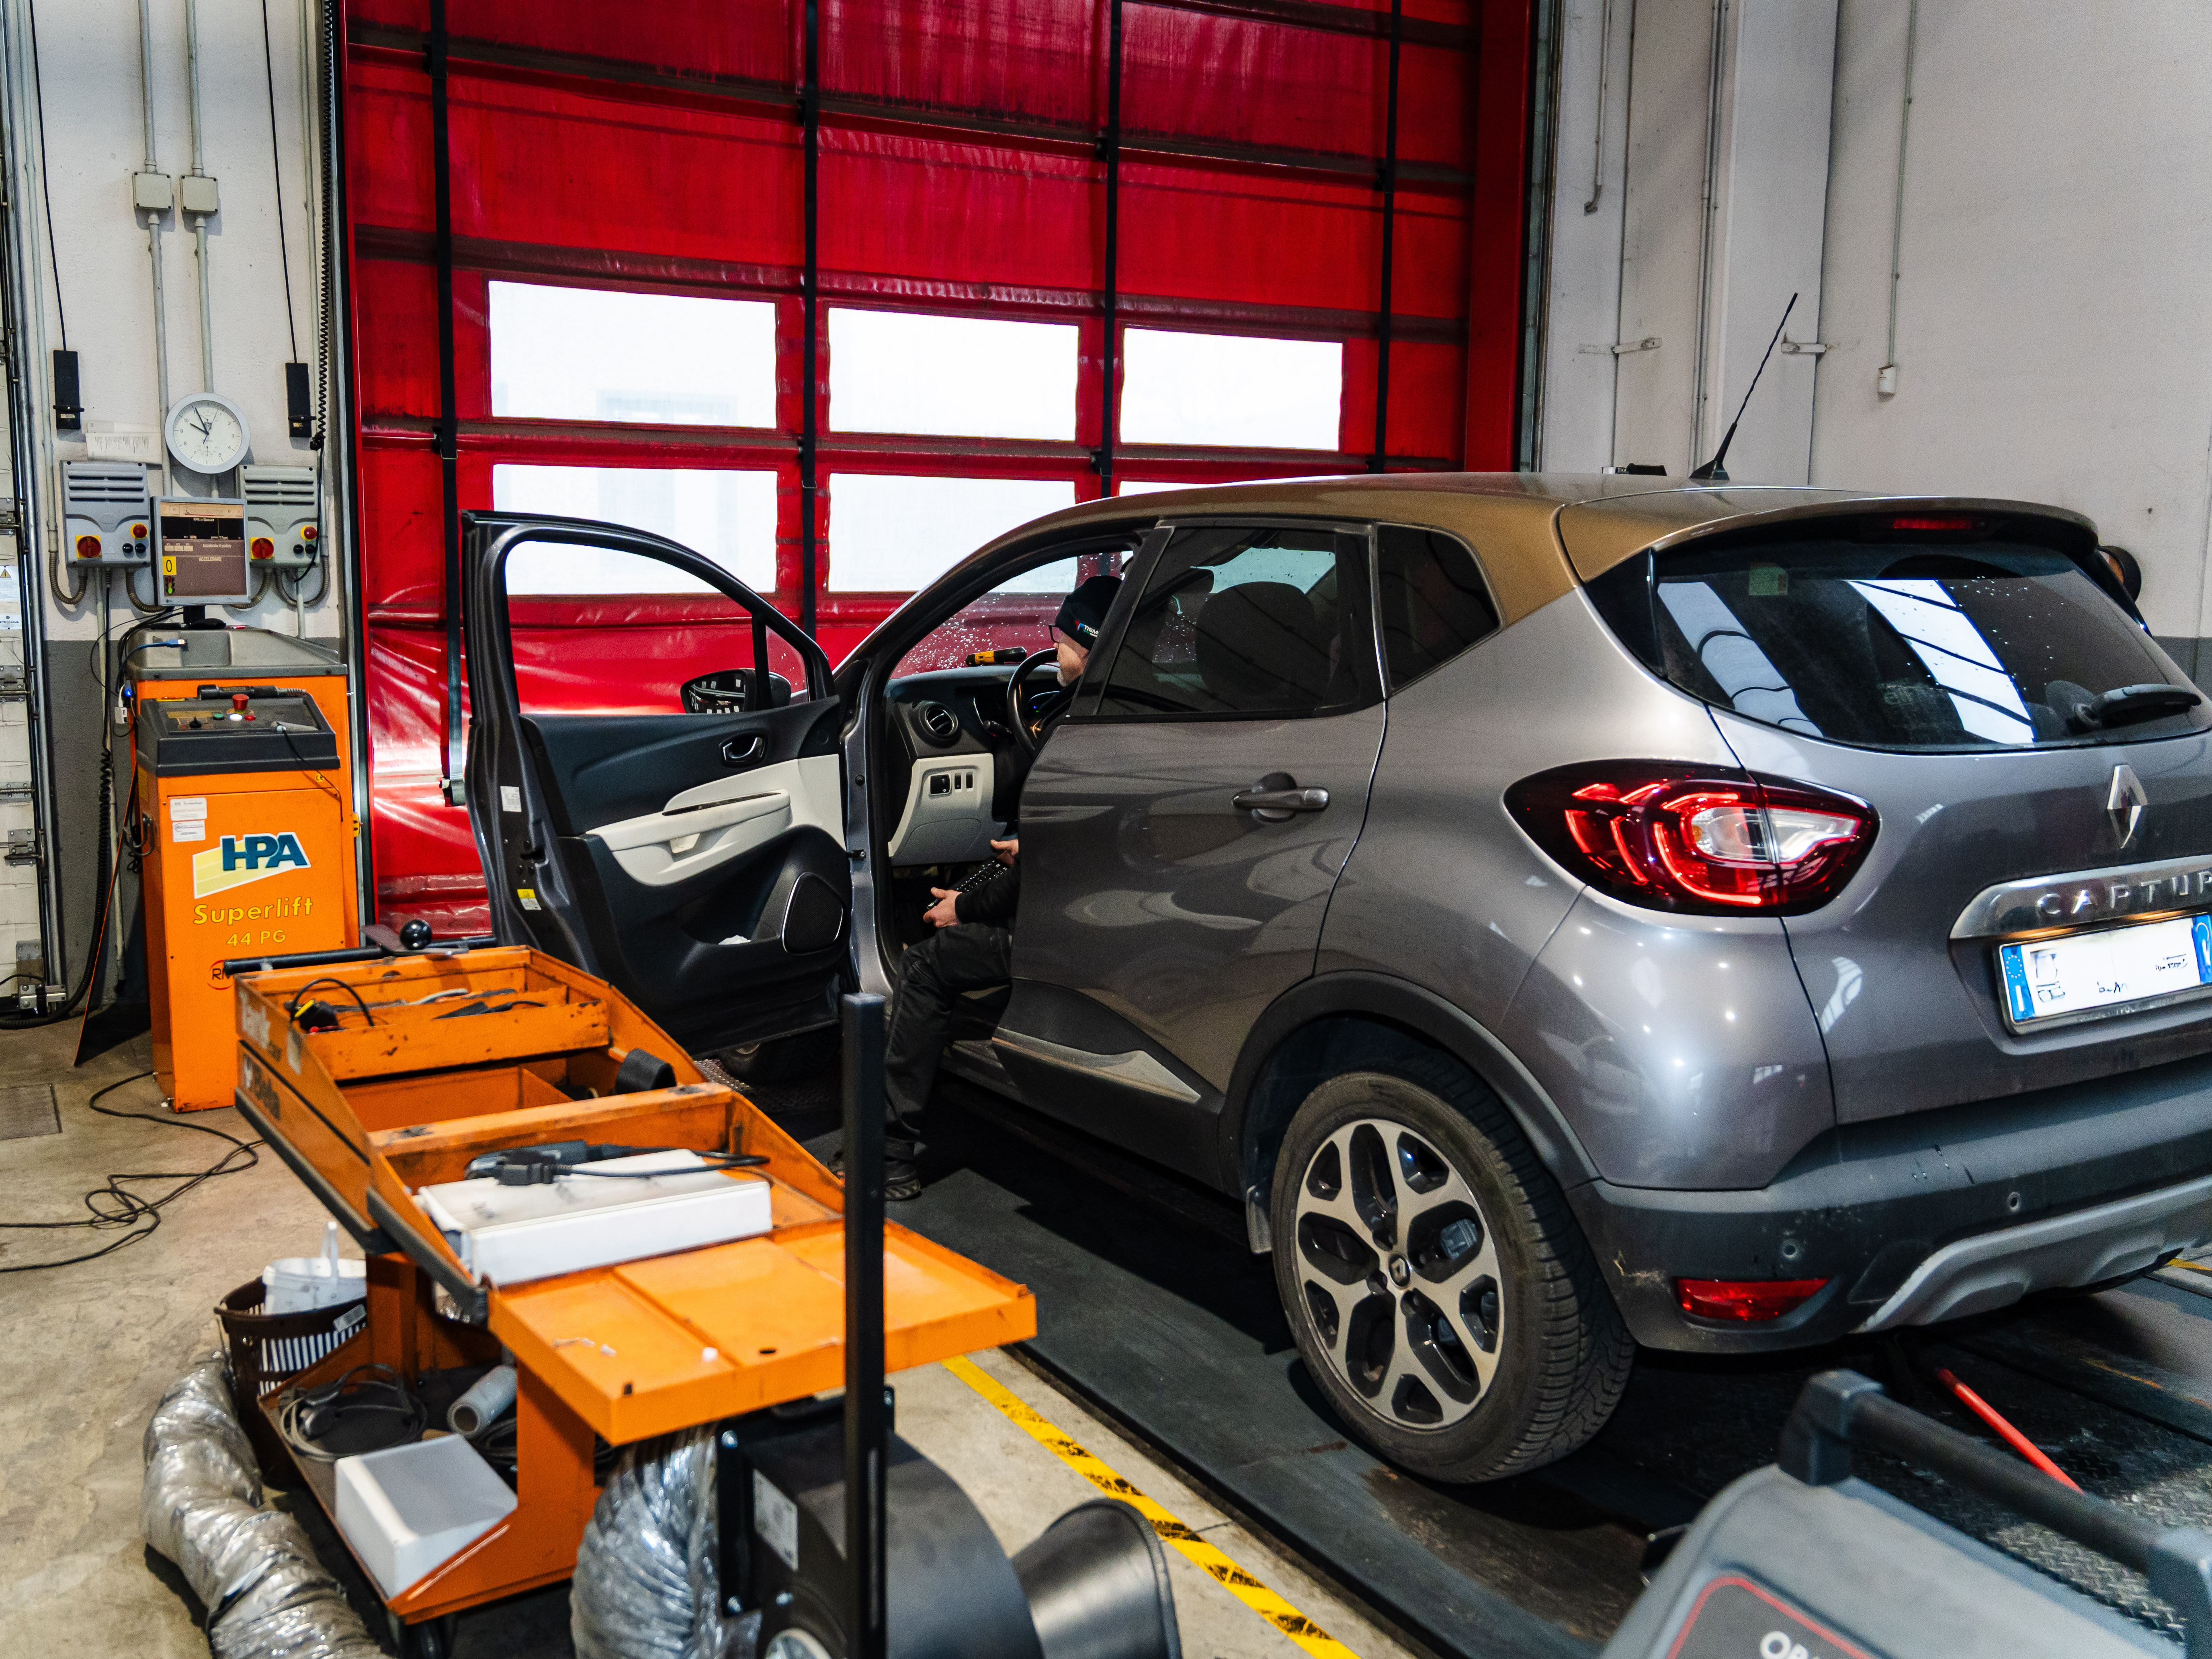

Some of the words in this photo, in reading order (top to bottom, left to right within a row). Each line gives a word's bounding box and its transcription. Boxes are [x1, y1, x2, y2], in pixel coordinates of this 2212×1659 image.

[166, 559, 172, 572] 0
[1084, 625, 1098, 635] TIEM
[222, 835, 308, 871] HPA
[193, 896, 313, 925] Superlift
[227, 932, 252, 946] 44
[260, 930, 286, 944] PG
